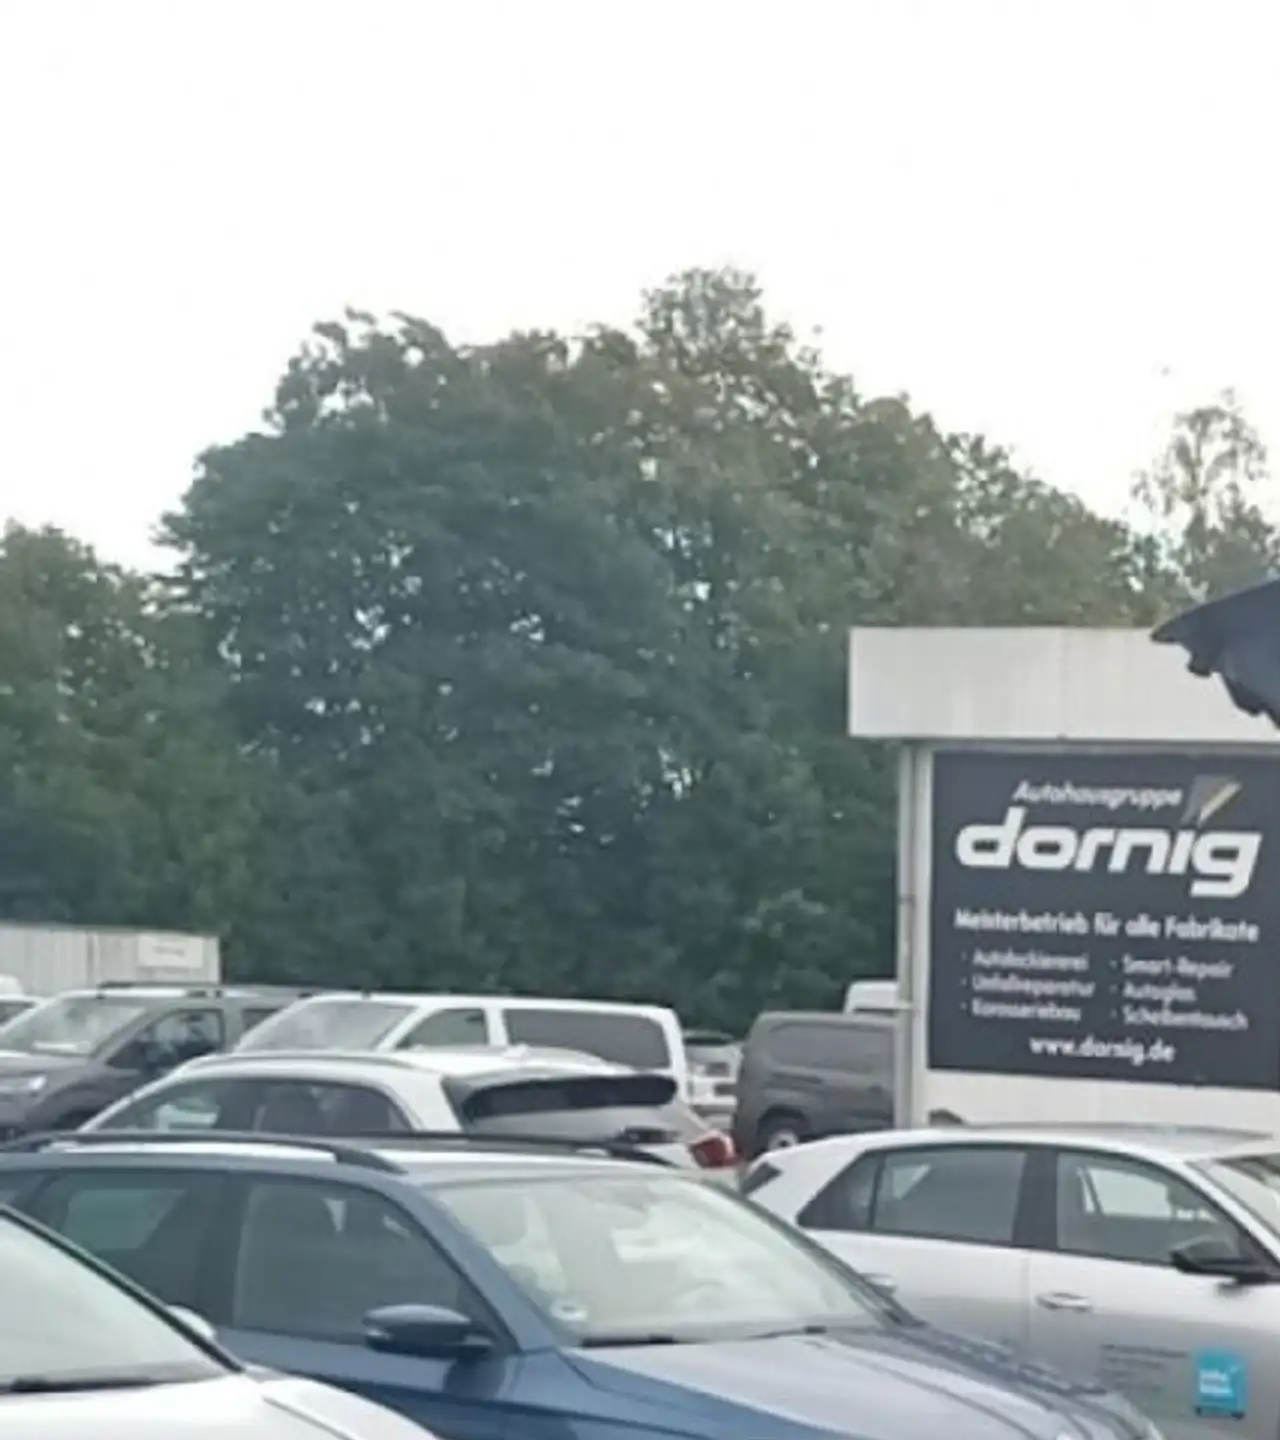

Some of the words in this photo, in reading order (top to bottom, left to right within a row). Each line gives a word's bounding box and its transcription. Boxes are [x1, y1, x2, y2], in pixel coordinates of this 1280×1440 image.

[955, 805, 1263, 898] dornig
[954, 908, 1089, 935] Meisterbetrieb
[1094, 912, 1120, 936] für
[1125, 913, 1161, 938] alle
[1165, 915, 1260, 942] Fabrikate
[1029, 1034, 1176, 1066] www.dornig.de
